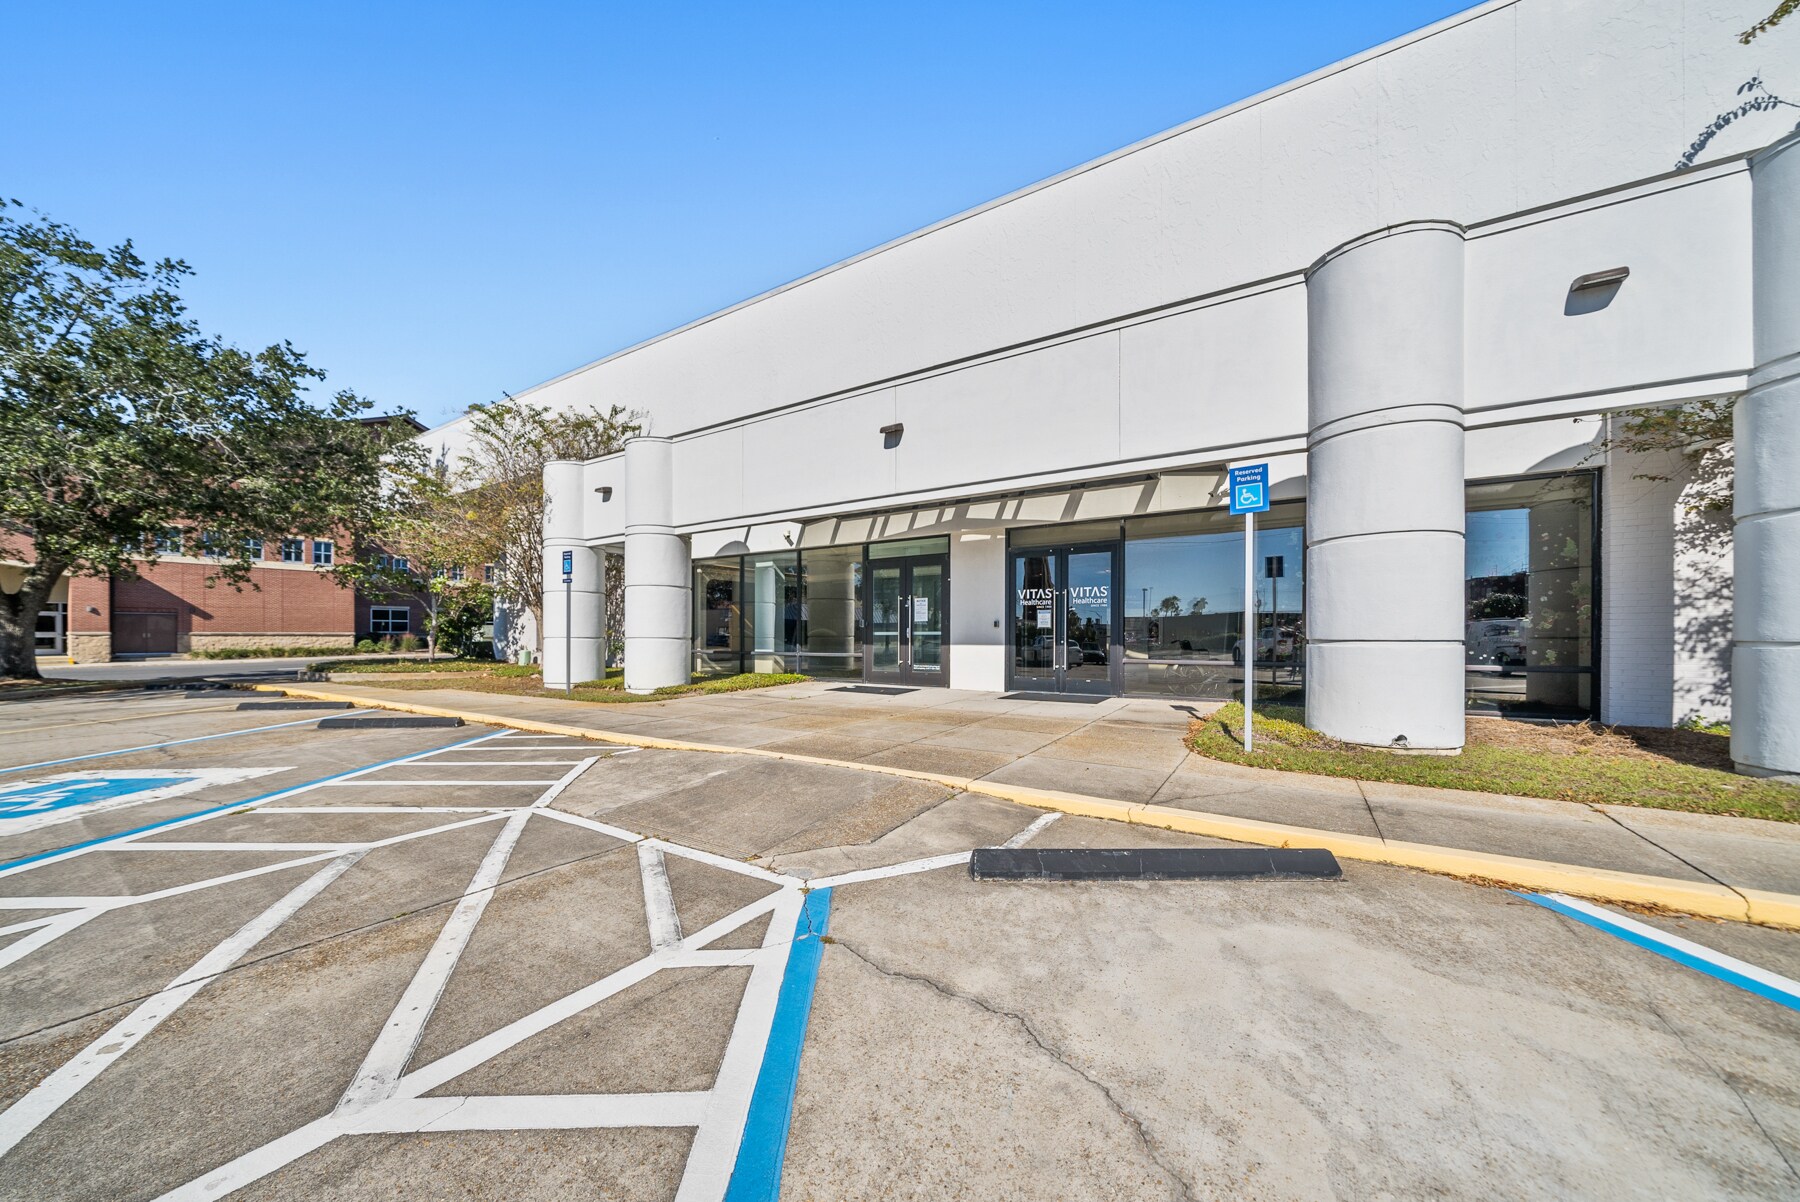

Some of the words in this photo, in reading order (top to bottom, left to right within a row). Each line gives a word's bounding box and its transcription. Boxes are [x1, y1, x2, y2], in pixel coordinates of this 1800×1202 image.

[1234, 467, 1263, 476] Reserved
[1017, 588, 1052, 599] VITAS
[1070, 585, 1108, 597] VITAS
[1072, 597, 1108, 605] Healthcare
